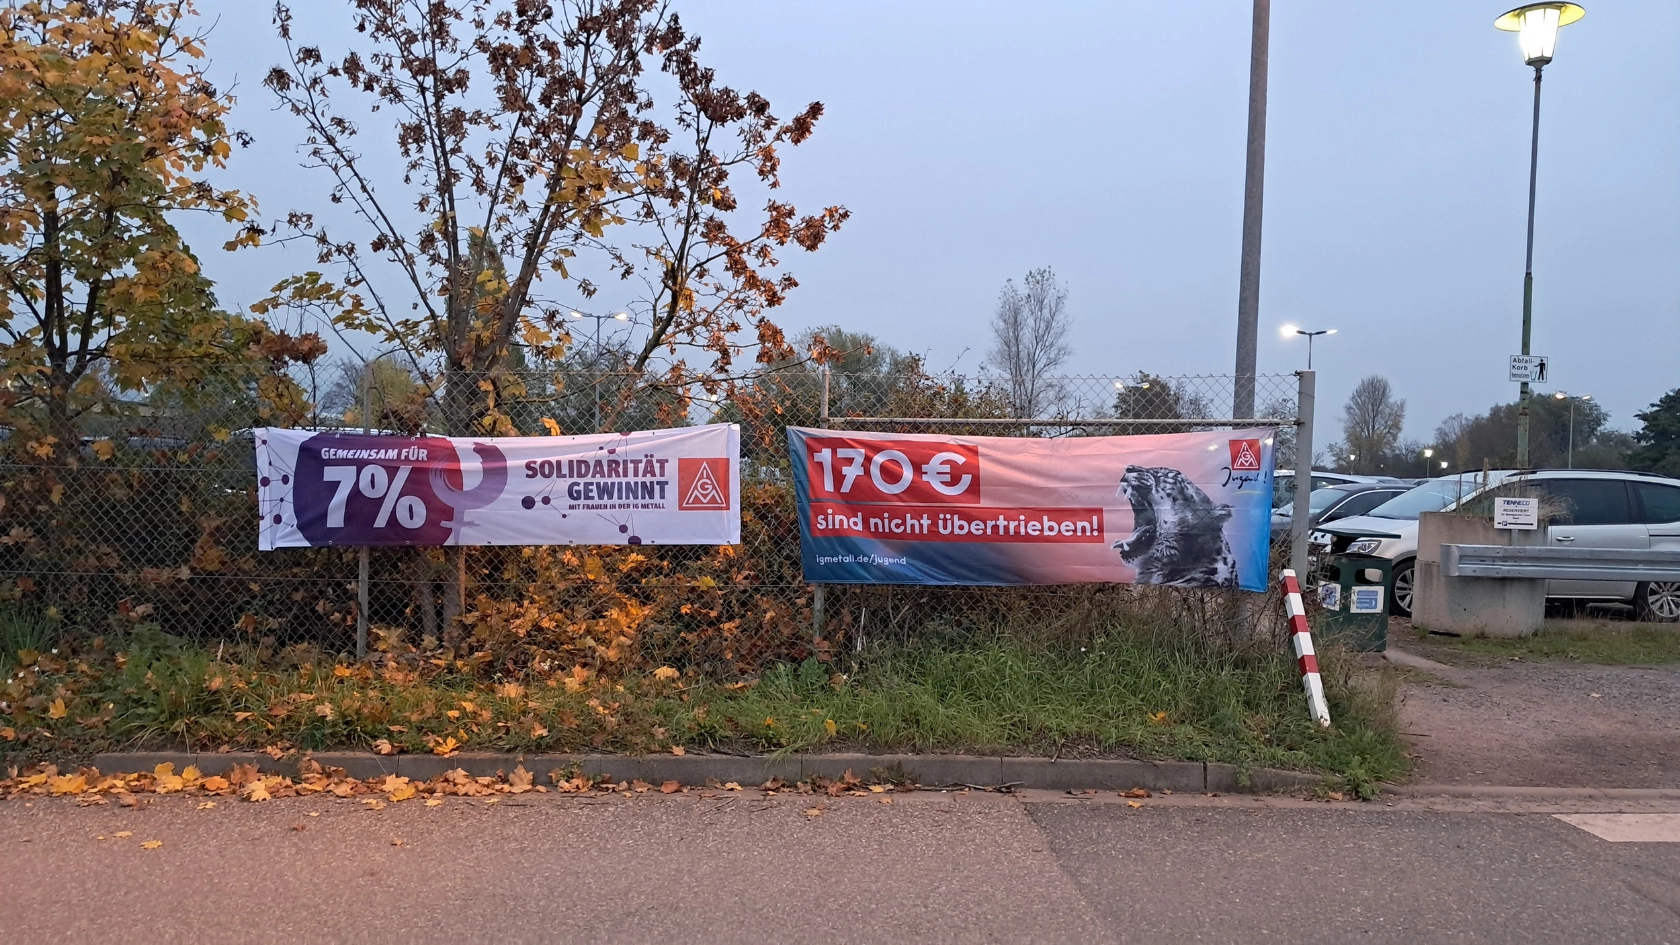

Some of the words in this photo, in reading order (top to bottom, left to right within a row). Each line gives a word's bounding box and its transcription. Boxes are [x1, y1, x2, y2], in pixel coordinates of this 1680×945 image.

[321, 448, 398, 460] GEMEINSAM
[400, 446, 428, 461] FÜR
[525, 454, 669, 479] SOLIDARITÄT
[813, 448, 914, 495] 170
[921, 451, 972, 496] €
[323, 464, 427, 529] 7%
[567, 480, 669, 501] GEWINNT
[816, 508, 863, 532] sind
[869, 512, 932, 534] nicht
[938, 514, 1099, 537] übertrieben!
[815, 553, 907, 566] igmetall.de/jugend
